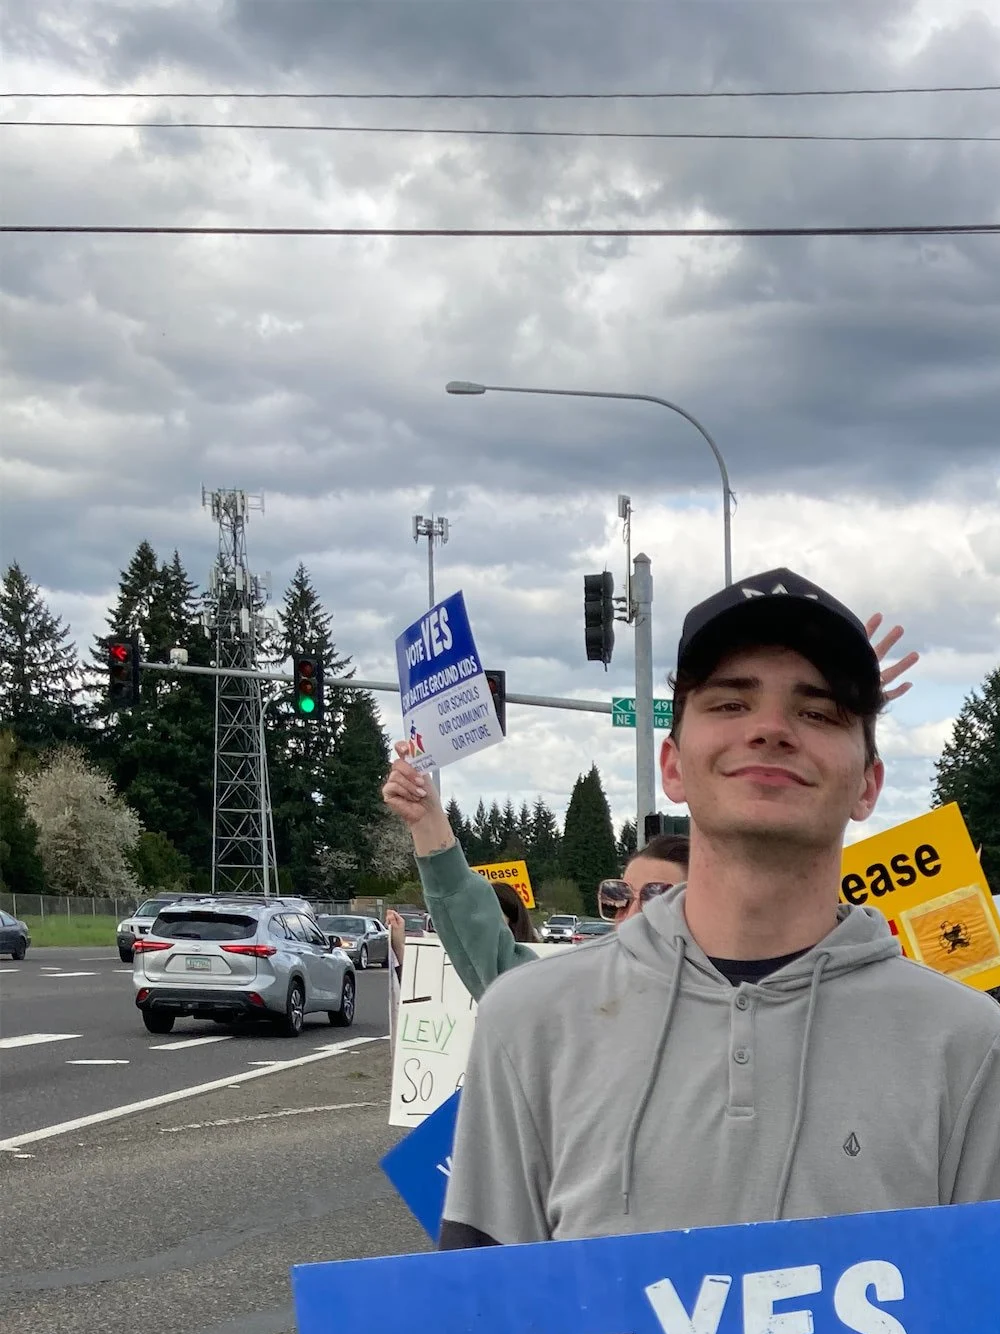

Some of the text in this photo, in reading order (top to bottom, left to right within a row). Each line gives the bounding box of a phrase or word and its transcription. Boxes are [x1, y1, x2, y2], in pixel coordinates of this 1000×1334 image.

[405, 606, 453, 670] VOTE YES
[410, 680, 430, 706] BATTLE
[428, 664, 459, 694] GROUND
[457, 655, 478, 679] KIDS
[437, 686, 480, 716] OUR SCHOOLS
[438, 702, 490, 737] OUR COMMUNITY
[451, 724, 492, 751] OUR FUTURE
[616, 714, 631, 725] NE
[477, 867, 519, 880] Please
[838, 844, 942, 906] ease
[401, 1013, 456, 1051] LEVY
[401, 1057, 434, 1104] SO
